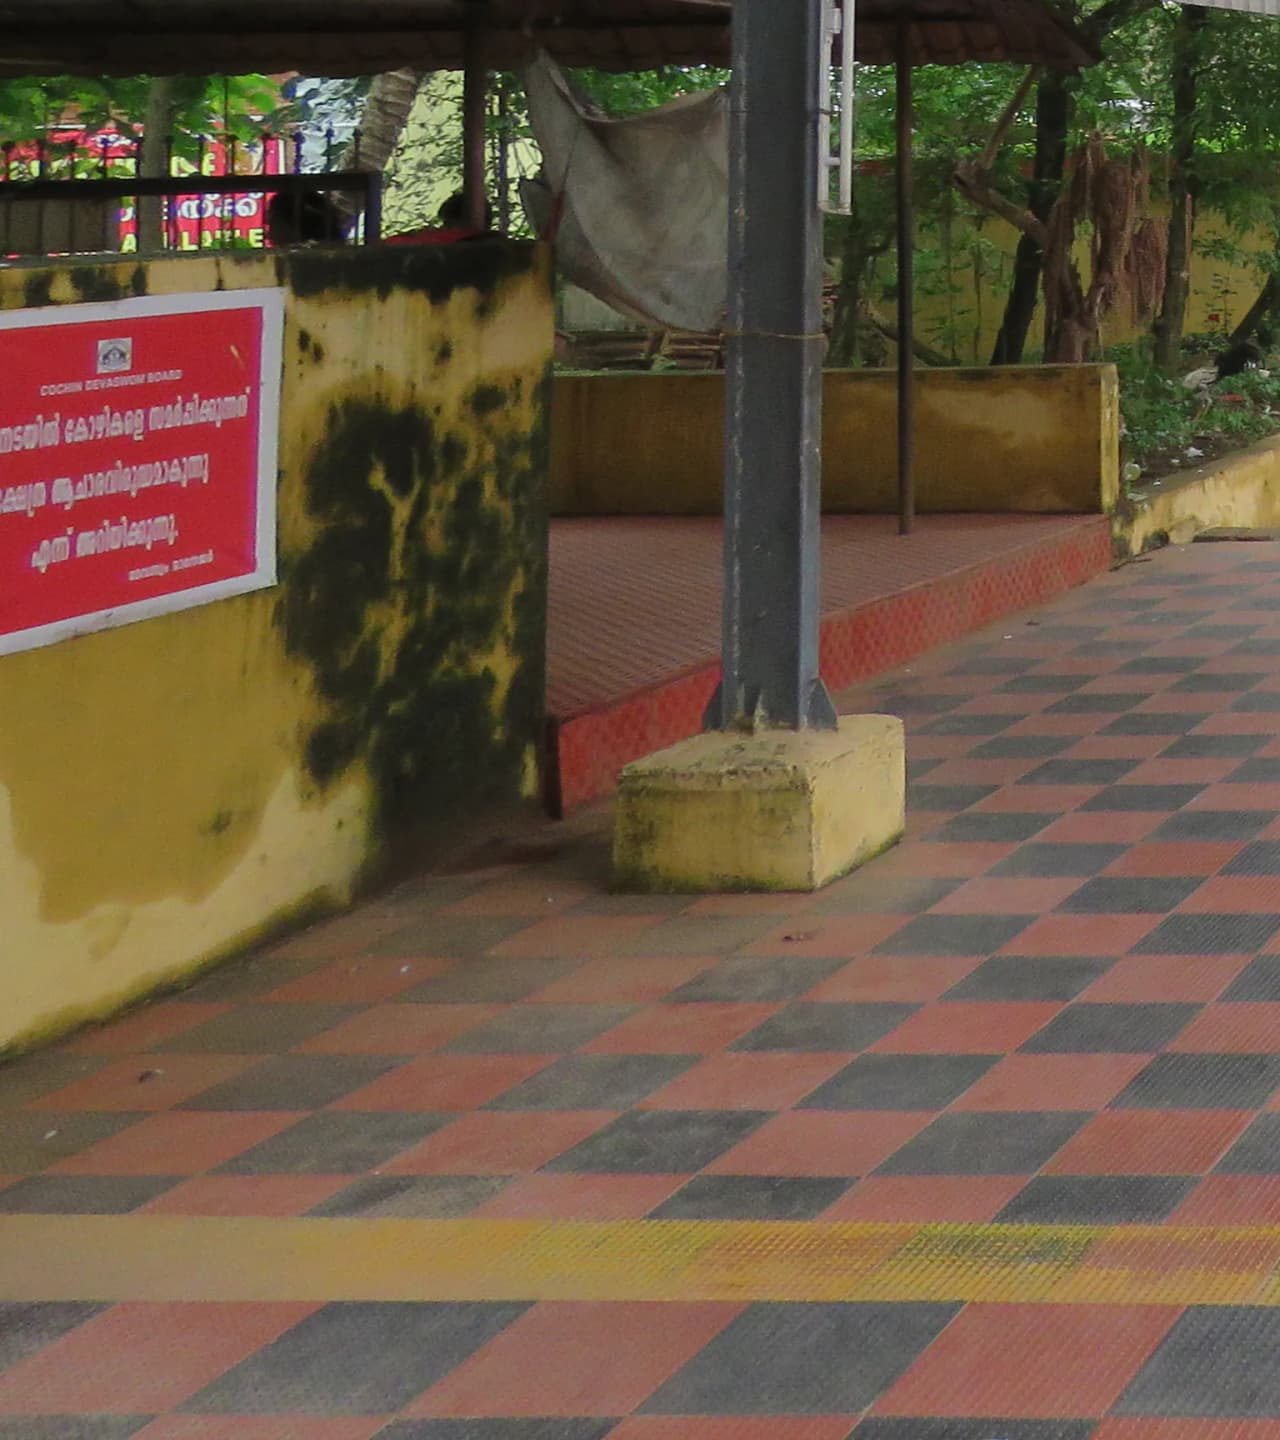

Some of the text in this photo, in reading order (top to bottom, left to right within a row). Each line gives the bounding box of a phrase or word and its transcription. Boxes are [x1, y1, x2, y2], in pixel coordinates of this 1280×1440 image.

[39, 369, 183, 396] COCHIN DEVASWOM BOARD
